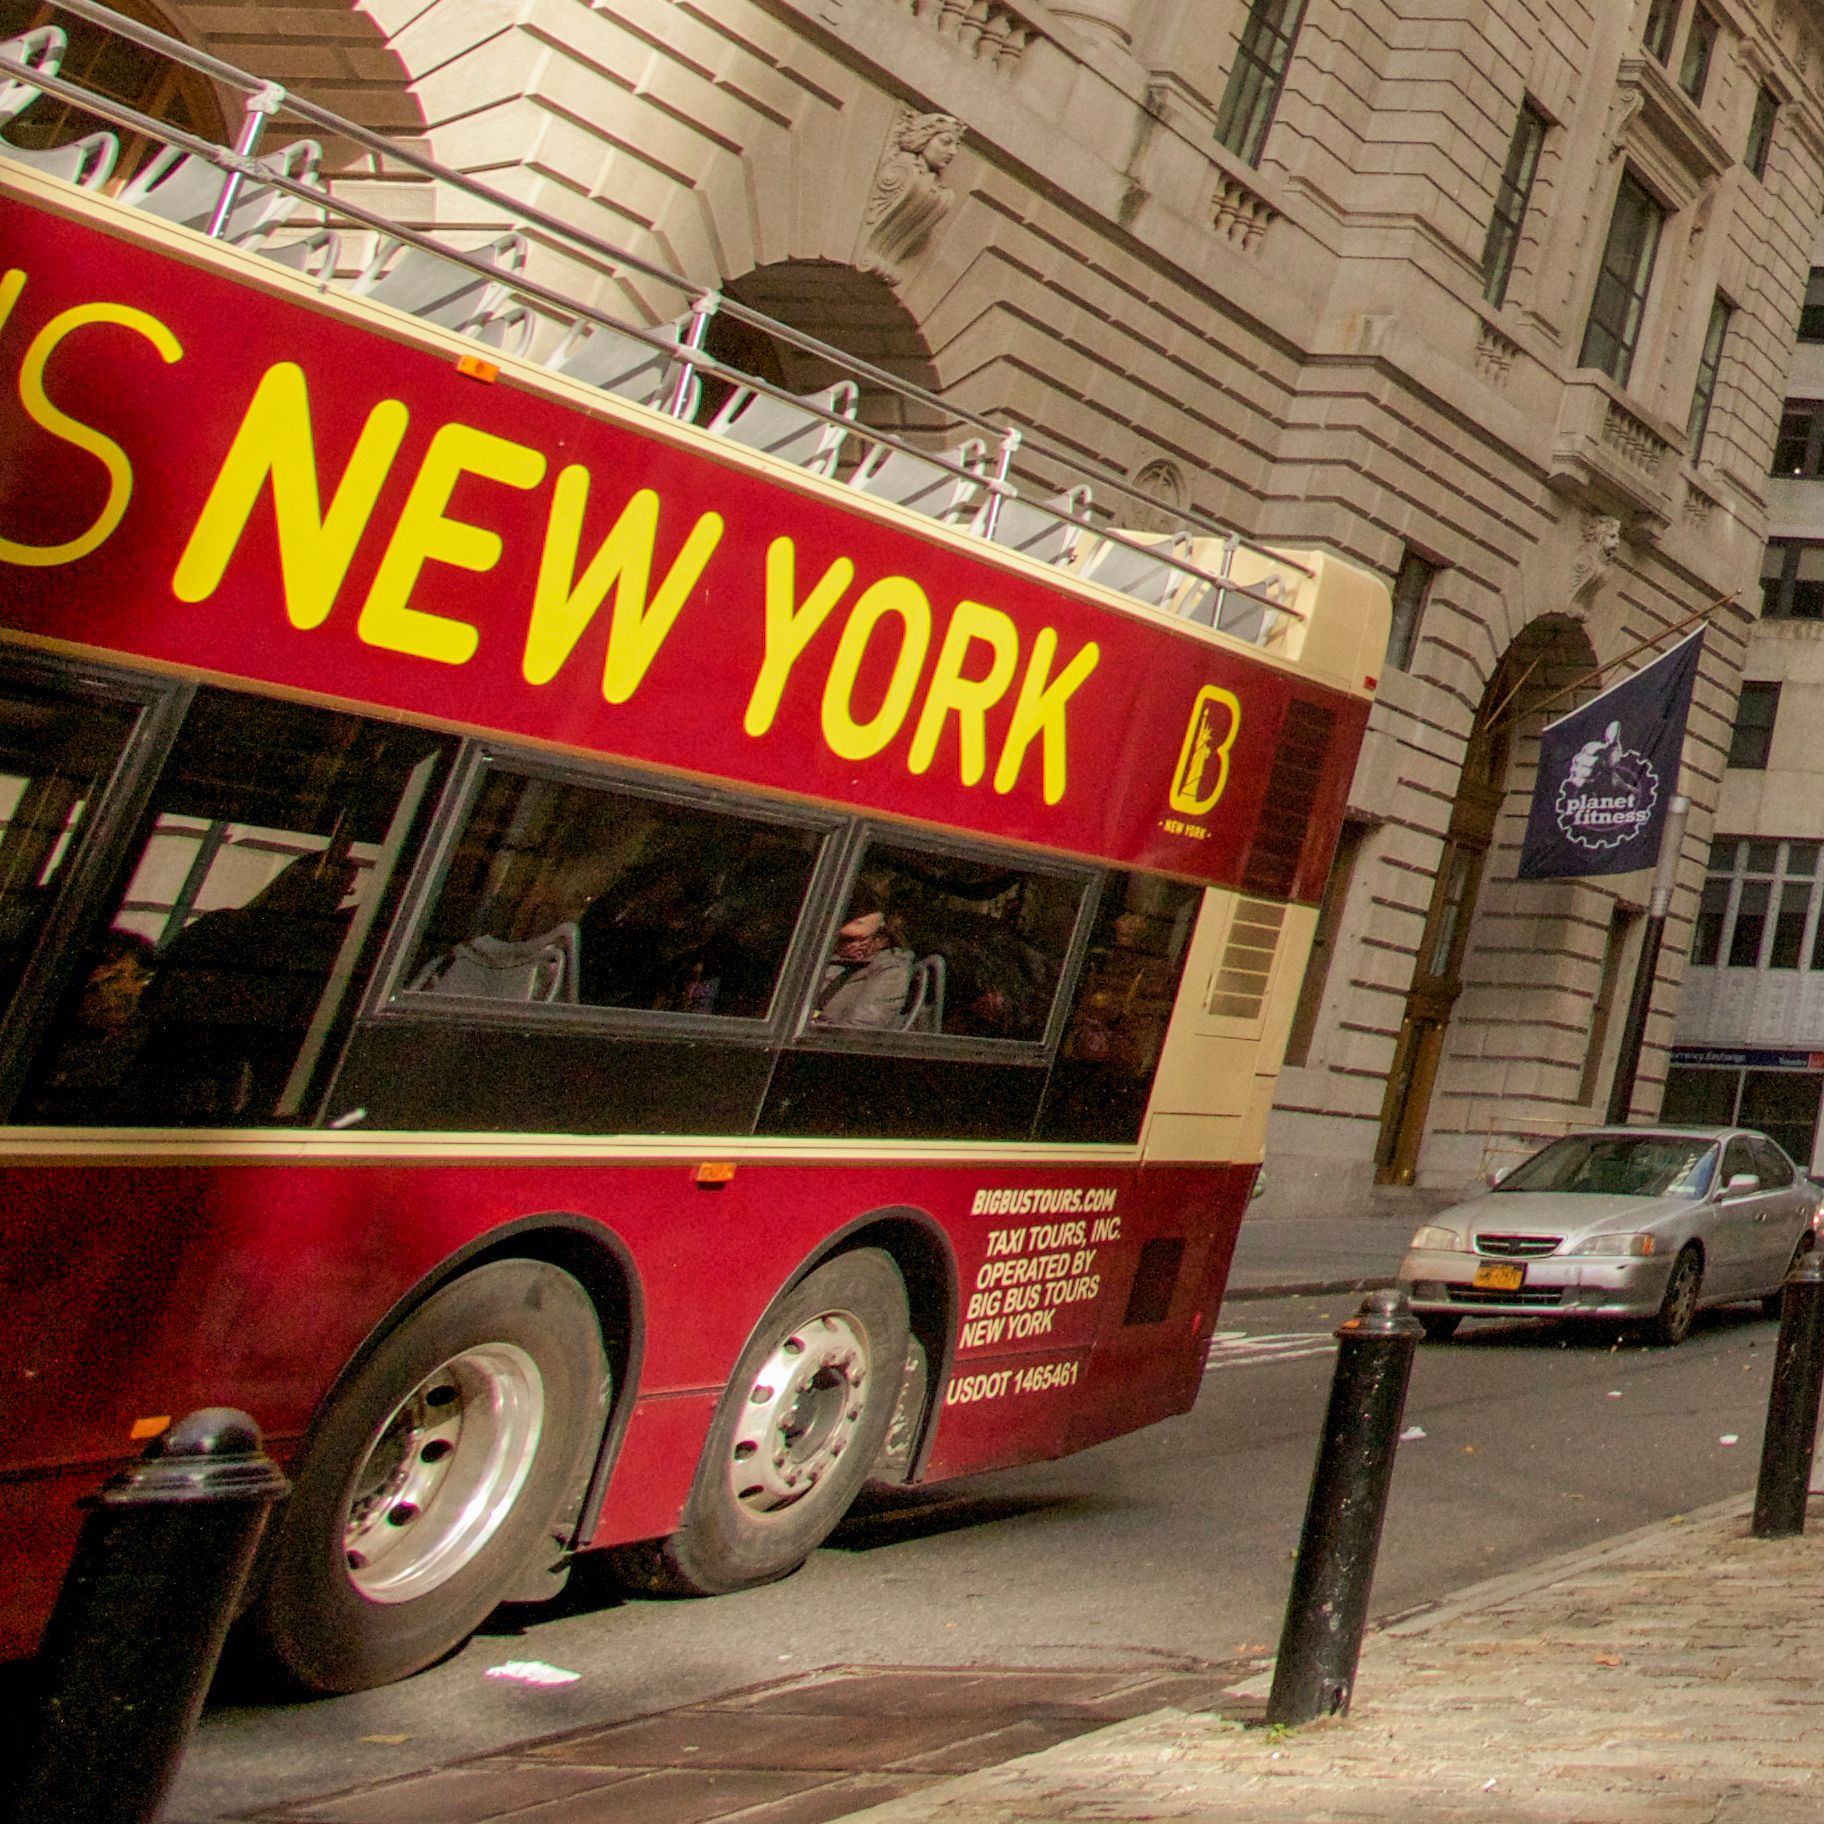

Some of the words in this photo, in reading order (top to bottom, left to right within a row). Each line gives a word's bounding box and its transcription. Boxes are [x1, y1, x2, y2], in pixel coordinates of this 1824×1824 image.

[0, 269, 185, 567] S
[172, 361, 724, 706] NEW
[744, 535, 1101, 806] YORK
[1566, 794, 1636, 816] planet
[1572, 809, 1648, 826] fitness
[1164, 819, 1184, 835] NEW
[1184, 824, 1207, 839] YORK
[971, 1188, 1117, 1216] BIGBUSTOURS.COM
[986, 1229, 1025, 1257] TAXI
[1028, 1223, 1087, 1254] TOURS,
[1091, 1217, 1121, 1243] INC.
[976, 1256, 1070, 1290] OPERATED
[1071, 1250, 1097, 1274] BY
[967, 1293, 1002, 1320] BIG
[1003, 1288, 1041, 1314] BUS
[1044, 1275, 1101, 1307] TOURS
[959, 1322, 1006, 1350] NEW
[1005, 1309, 1056, 1340] YORK
[946, 1370, 1013, 1406] USDOT
[1014, 1360, 1080, 1395] 1465461
